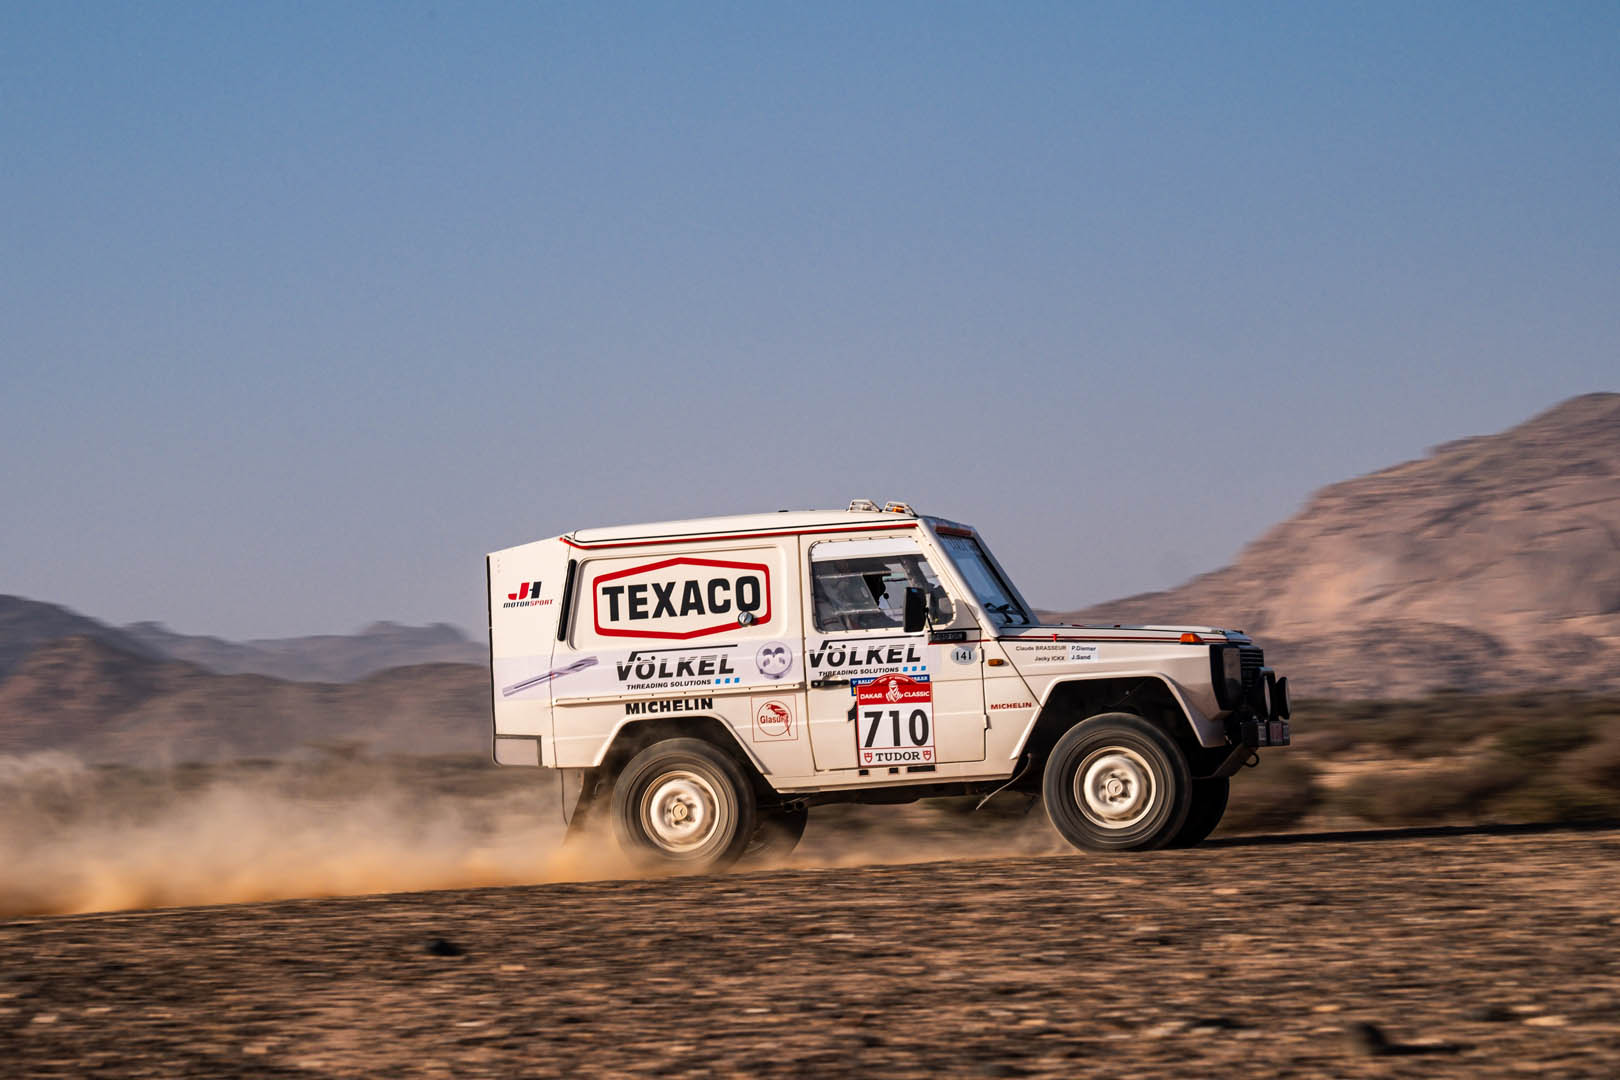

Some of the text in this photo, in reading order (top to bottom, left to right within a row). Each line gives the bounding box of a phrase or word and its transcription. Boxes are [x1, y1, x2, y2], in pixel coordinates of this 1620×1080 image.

[503, 599, 553, 608] MOTORSPORT
[602, 576, 761, 622] TEXACO
[809, 640, 921, 668] VÖLKEL
[956, 650, 972, 661] 141
[616, 648, 736, 681] VÖLKEL
[818, 667, 899, 677] THREADING SOLUTIONS
[626, 679, 712, 690] THREADING SOLUTIONS
[625, 698, 714, 715] MICHELIN
[864, 708, 930, 748] 710
[875, 751, 920, 762] TUDOR
